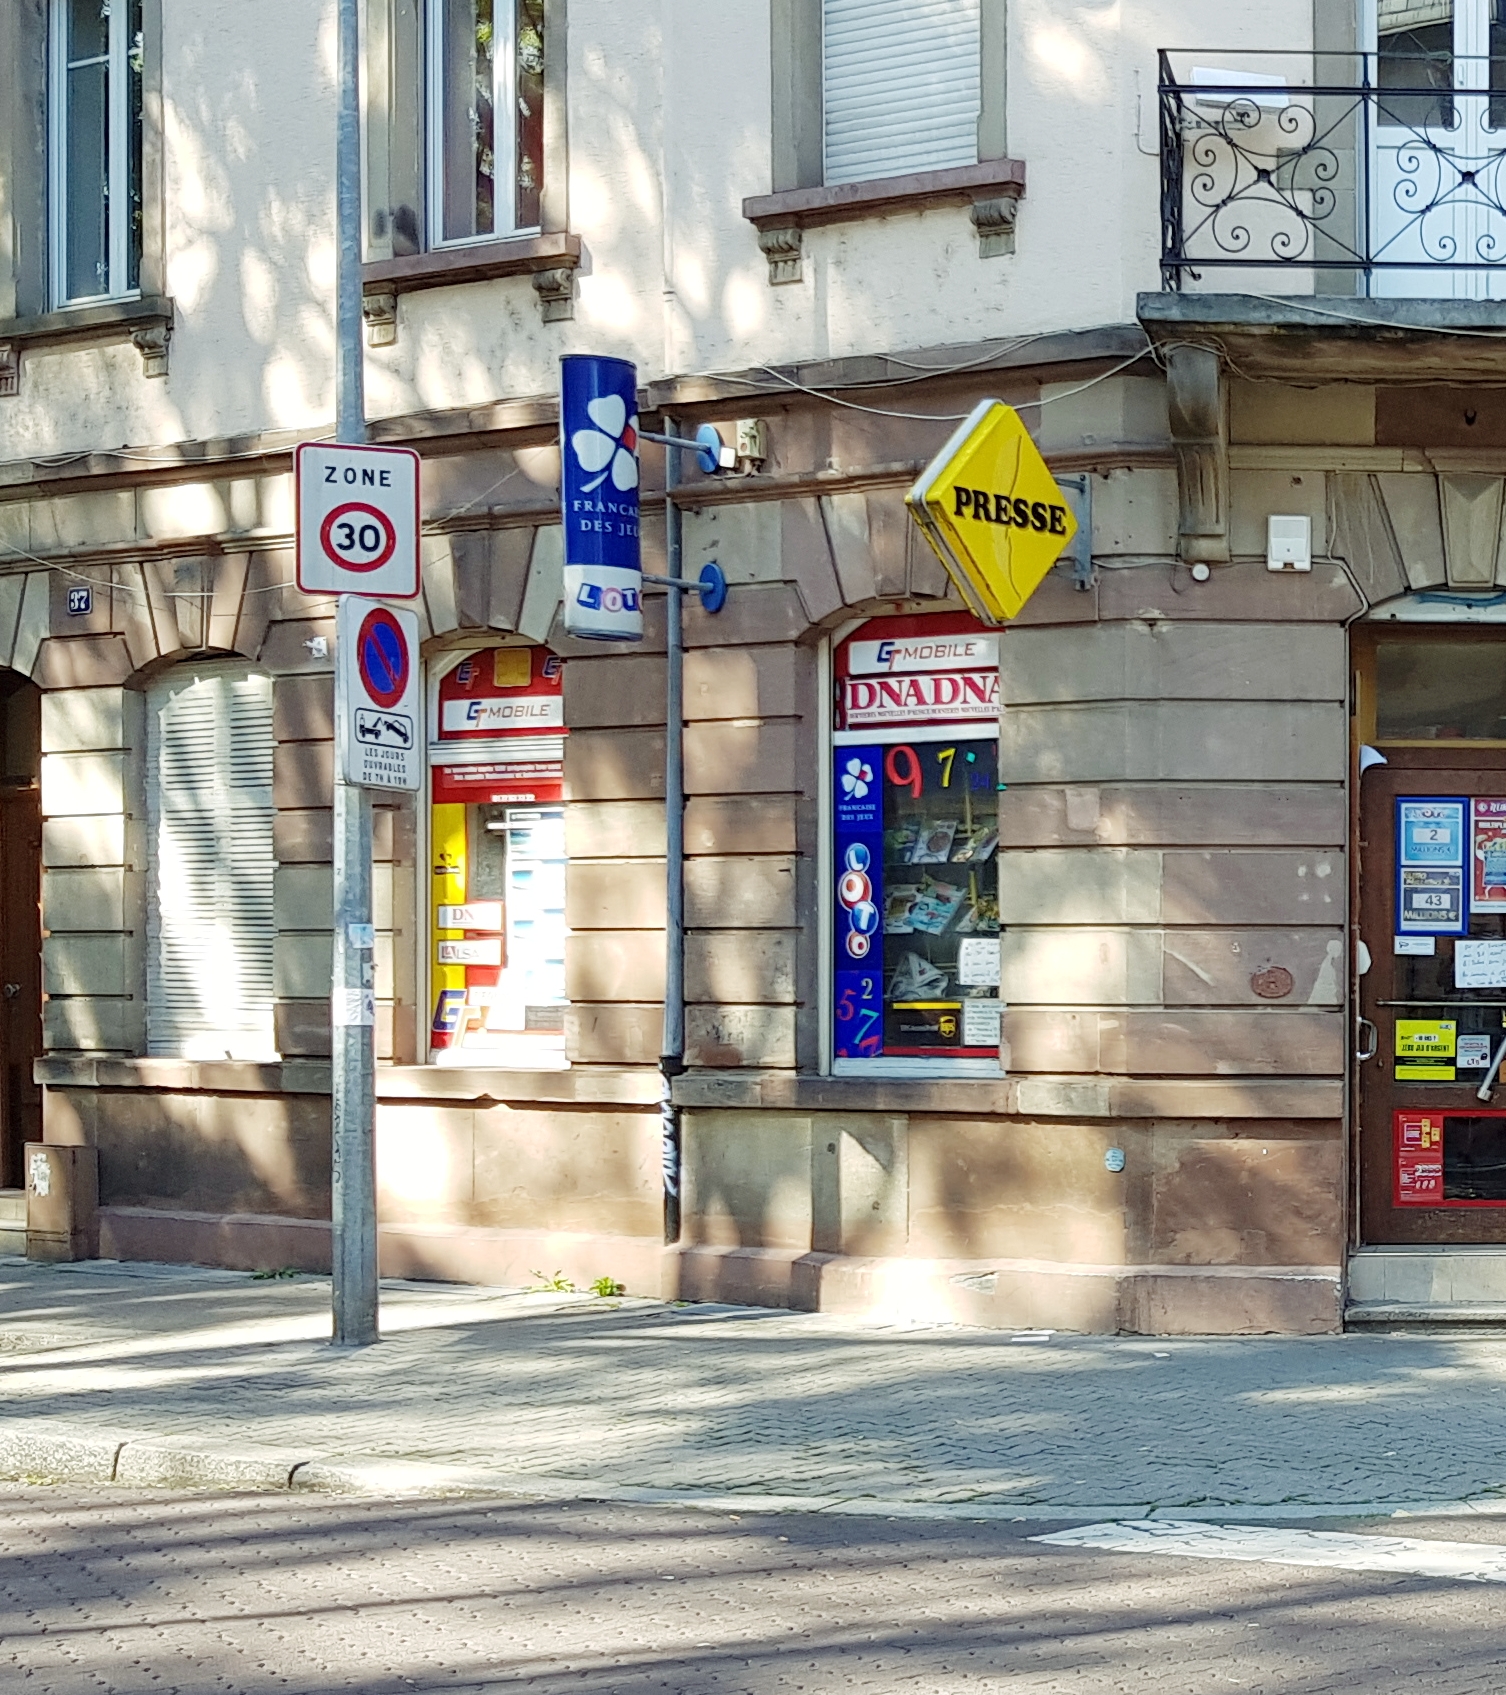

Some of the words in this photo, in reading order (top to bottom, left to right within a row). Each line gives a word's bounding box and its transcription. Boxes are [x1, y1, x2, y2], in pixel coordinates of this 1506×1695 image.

[324, 465, 392, 488] ZONE
[953, 485, 1067, 536] PRESSE
[580, 519, 613, 533] DES
[335, 522, 381, 553] 30
[70, 590, 88, 610] 37
[576, 583, 643, 613] LOT
[903, 642, 977, 660] MOBILE
[849, 678, 930, 710] DNA
[487, 704, 551, 719] MOBILE
[364, 747, 380, 759] LES
[380, 748, 406, 762] JOURS
[363, 760, 407, 774] OUVRABLES
[362, 771, 373, 782] DE
[1429, 829, 1439, 841] 2
[1425, 894, 1443, 907] 43
